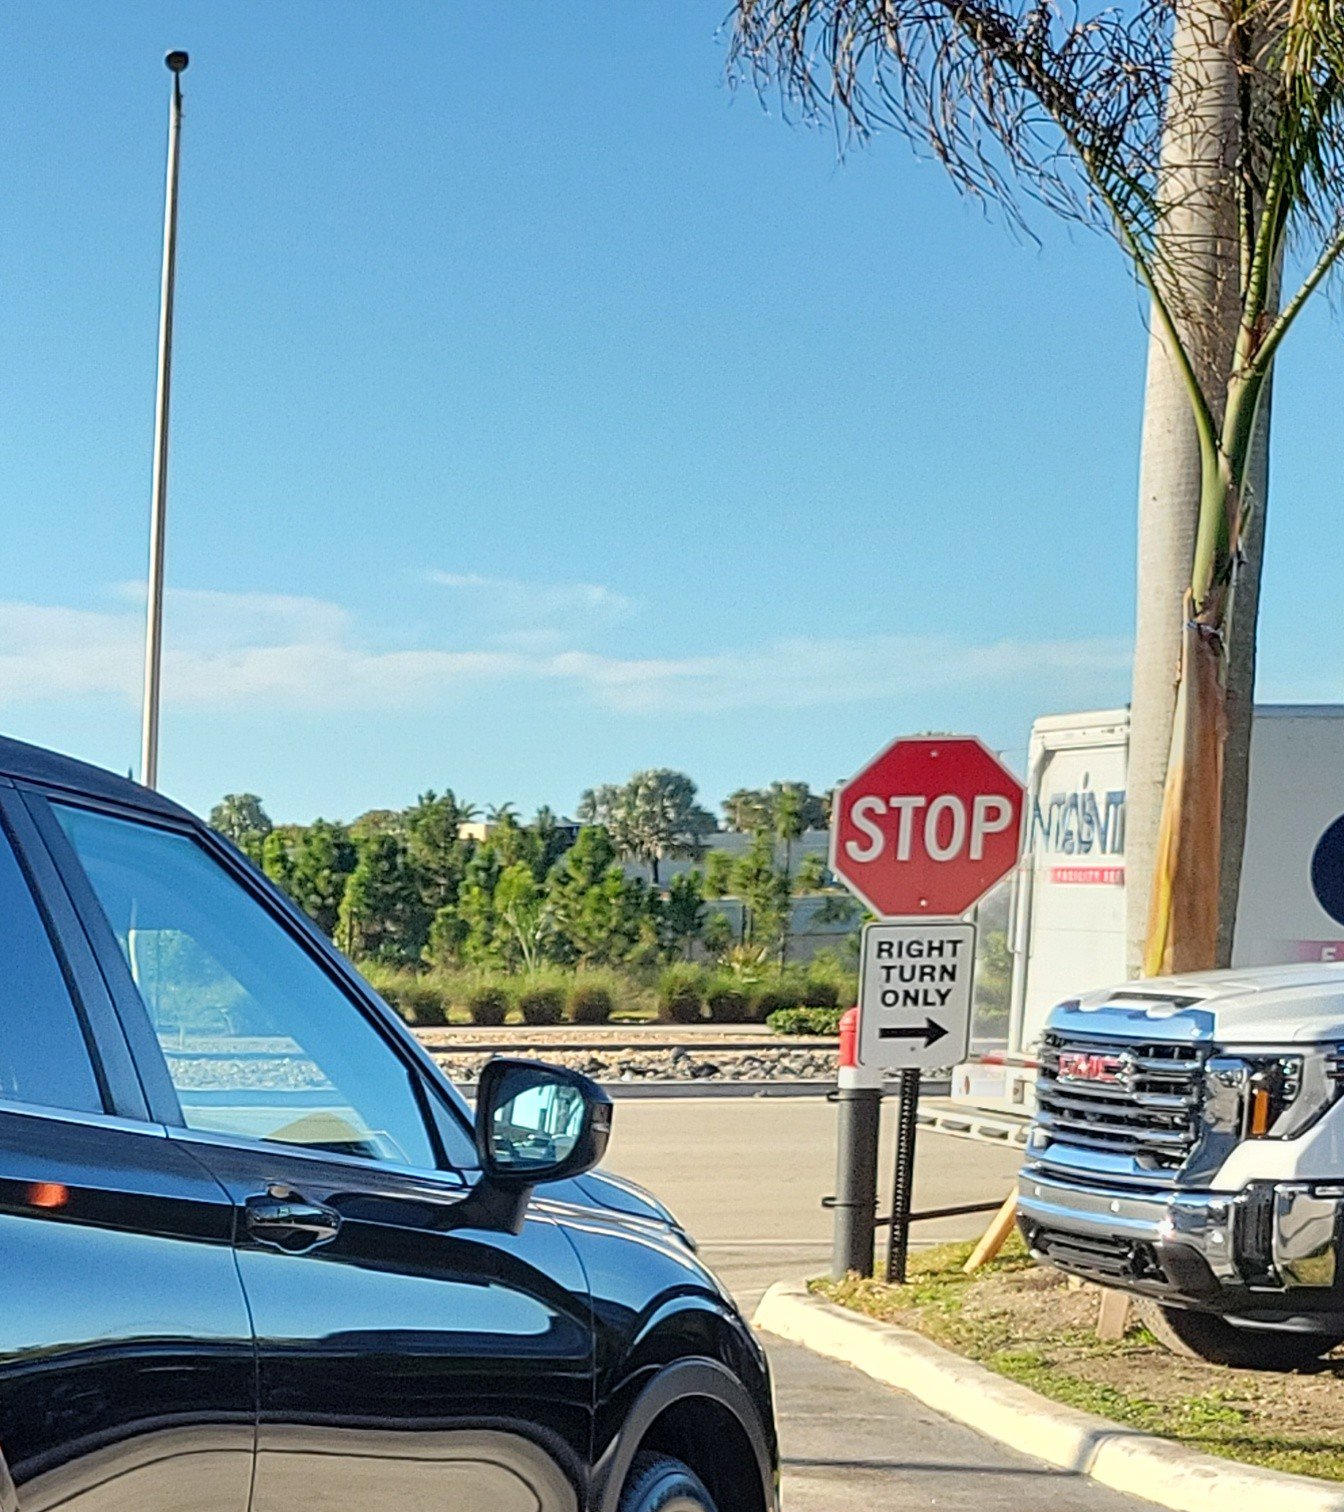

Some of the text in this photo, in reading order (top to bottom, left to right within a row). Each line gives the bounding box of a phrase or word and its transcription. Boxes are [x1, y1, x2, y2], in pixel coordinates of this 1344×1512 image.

[845, 794, 1013, 864] STOP
[876, 939, 964, 960] RIGHT
[881, 965, 958, 984] TURN
[881, 989, 954, 1008] ONLY
